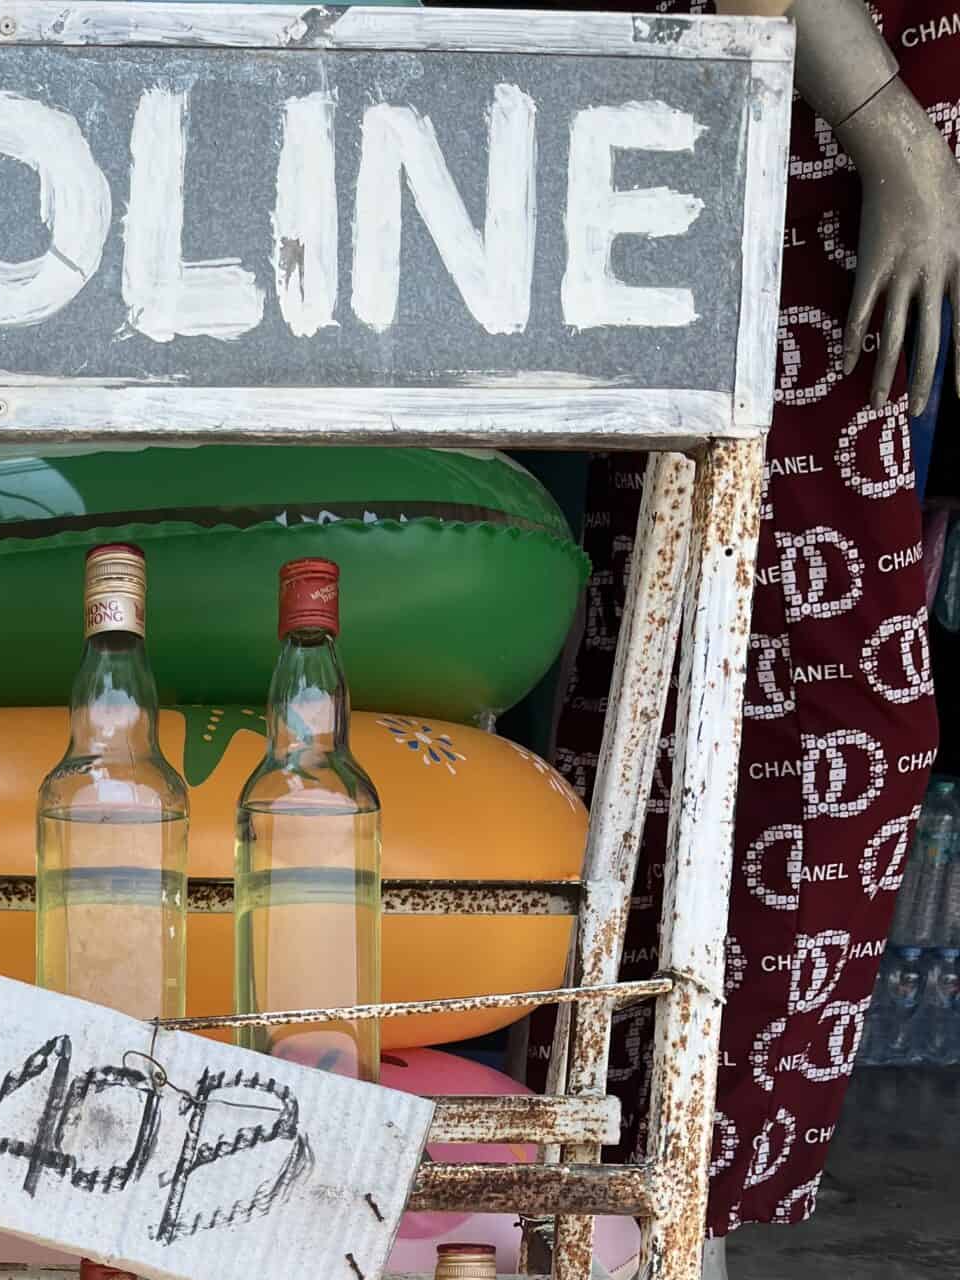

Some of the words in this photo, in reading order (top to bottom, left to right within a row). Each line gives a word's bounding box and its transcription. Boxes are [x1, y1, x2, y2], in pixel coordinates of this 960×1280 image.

[770, 455, 823, 476] ANEL
[793, 663, 853, 684] ANEL
[800, 863, 849, 883] ANEL
